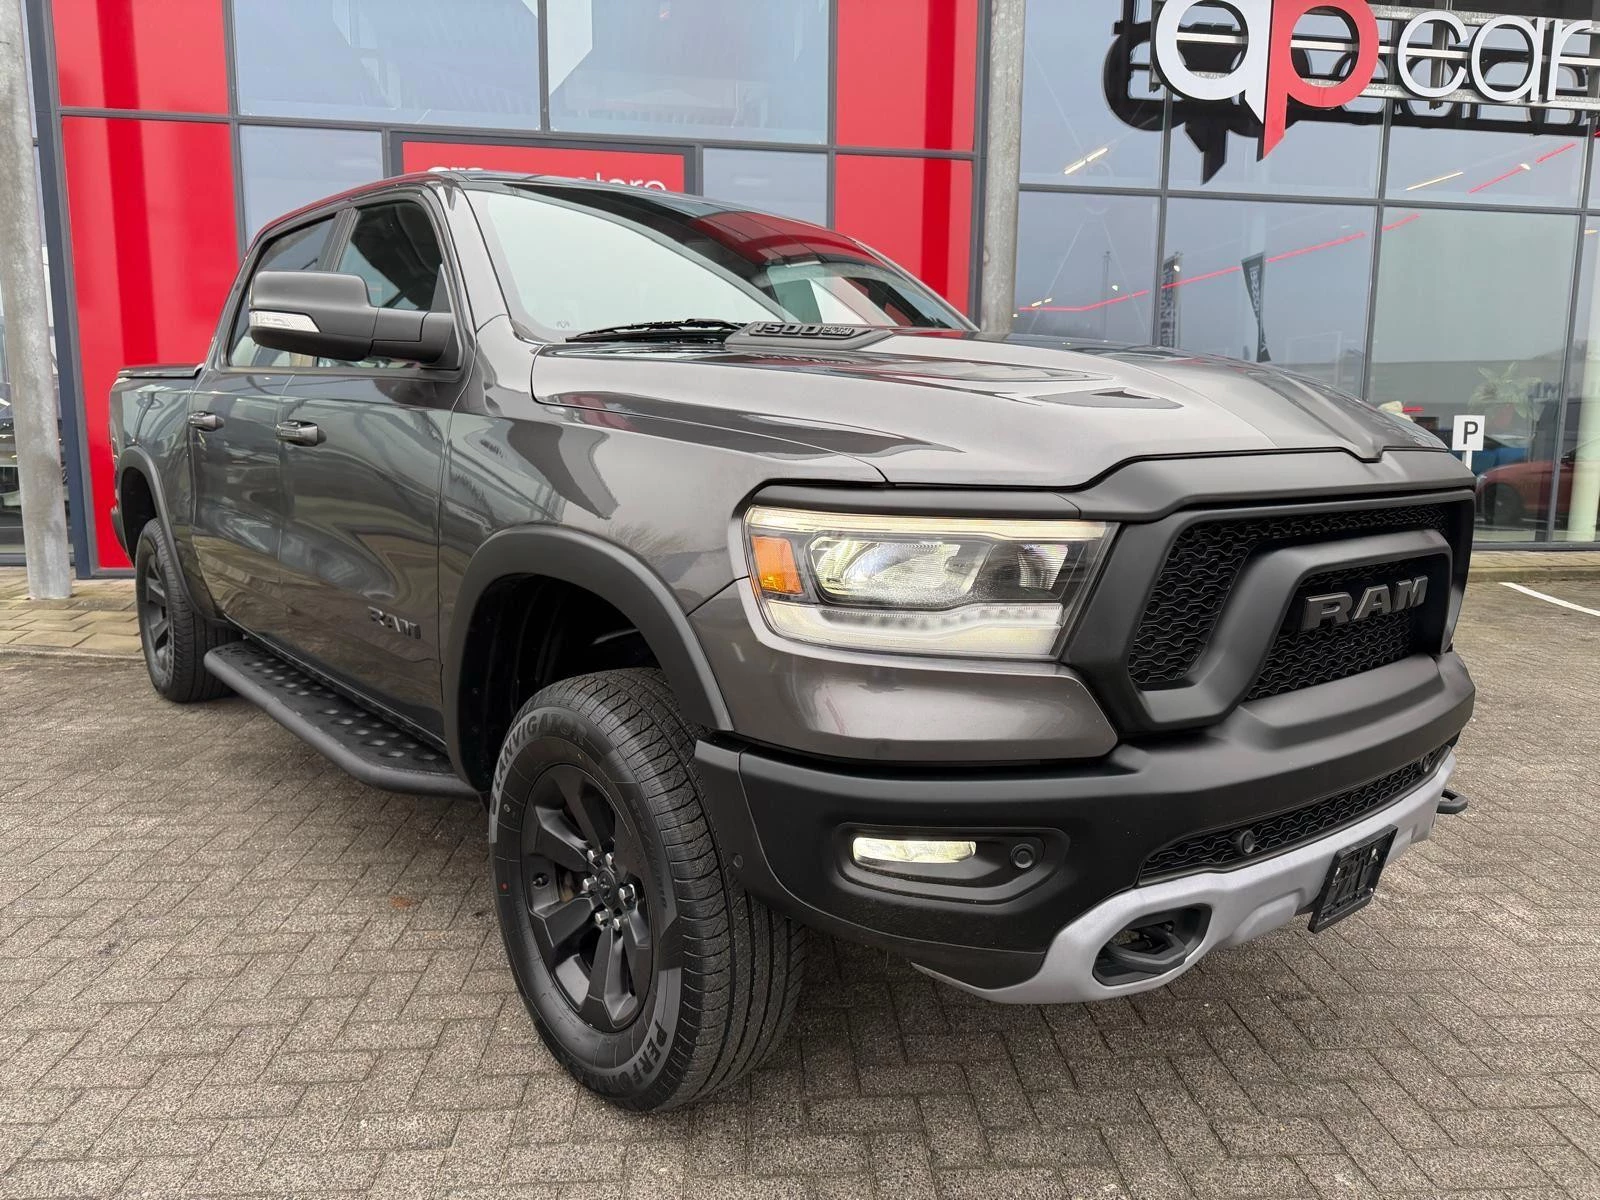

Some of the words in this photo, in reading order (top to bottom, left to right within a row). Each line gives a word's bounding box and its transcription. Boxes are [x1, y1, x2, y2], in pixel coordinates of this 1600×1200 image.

[1398, 10, 1593, 103] car
[754, 322, 821, 335] 1500
[1463, 421, 1478, 445] P
[1302, 575, 1429, 630] RAM
[367, 606, 421, 640] RAM
